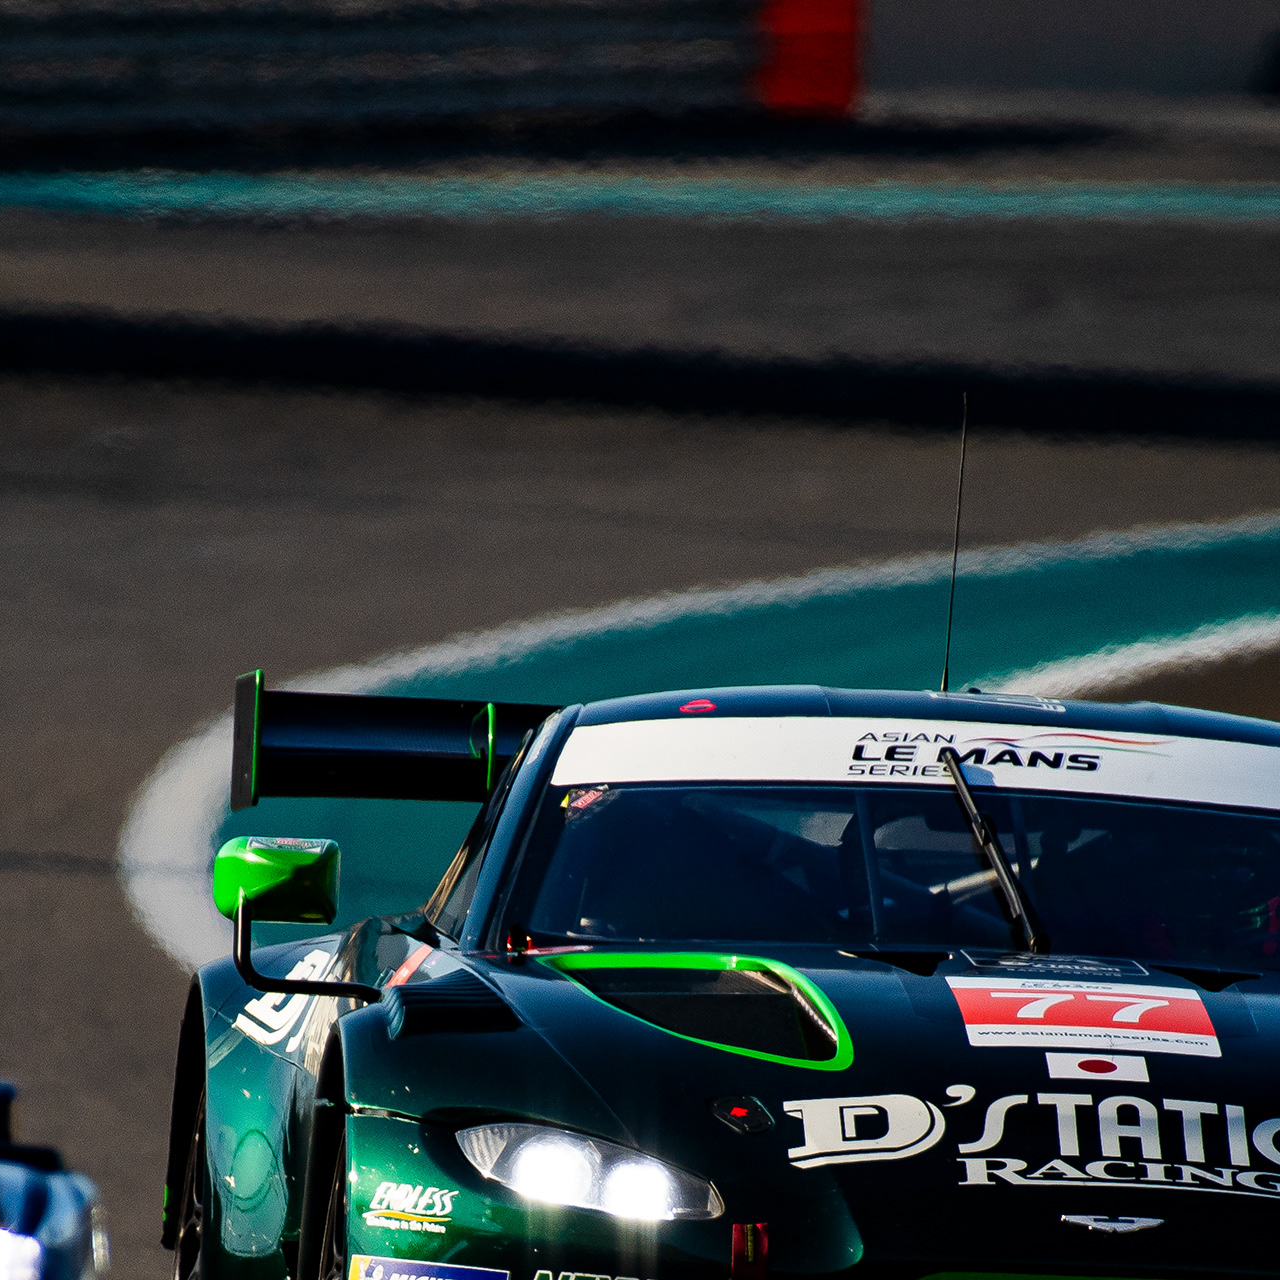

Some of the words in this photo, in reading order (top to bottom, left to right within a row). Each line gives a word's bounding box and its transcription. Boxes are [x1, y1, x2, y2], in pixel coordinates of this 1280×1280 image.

[857, 732, 956, 744] ASIAN
[852, 744, 917, 763] LE
[936, 746, 1101, 772] MANS
[990, 991, 1170, 1023] 77
[369, 1181, 459, 1216] ENDLESS
